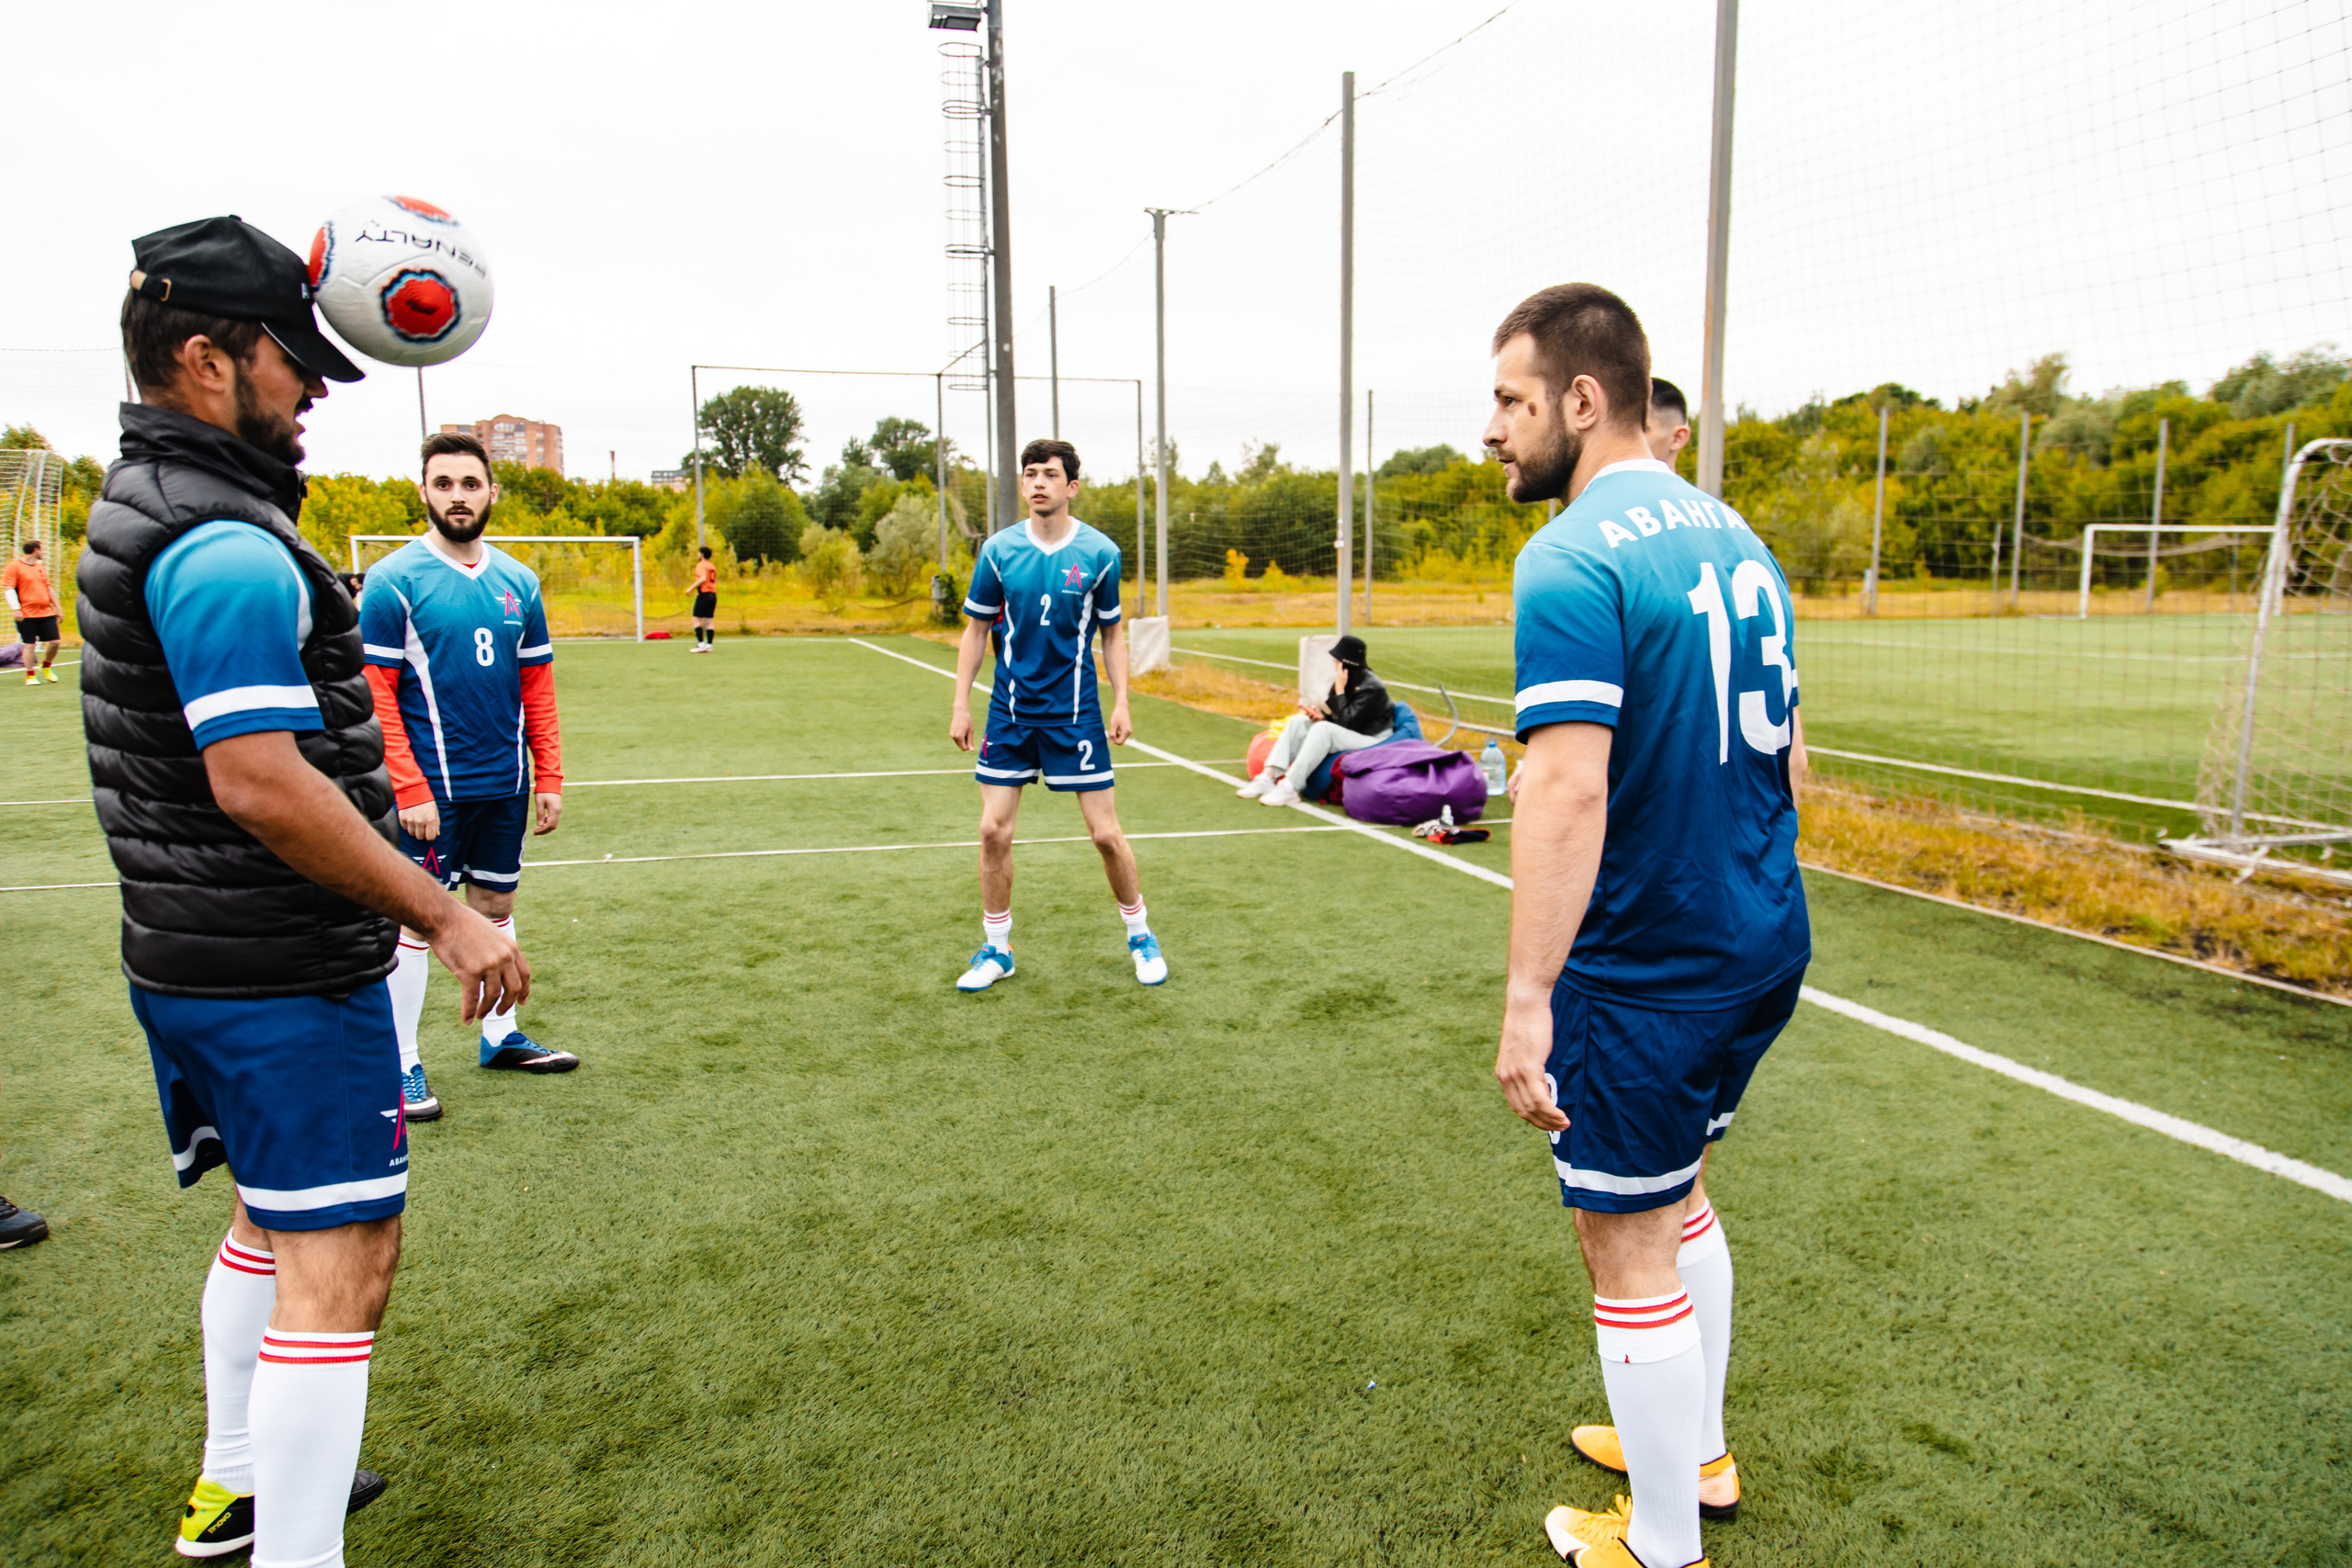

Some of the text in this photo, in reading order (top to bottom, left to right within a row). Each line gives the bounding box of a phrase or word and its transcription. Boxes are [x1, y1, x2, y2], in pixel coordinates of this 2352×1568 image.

[355, 229, 487, 278] PENALTY
[1598, 499, 1765, 548] АВАНГА
[1040, 593, 1051, 626] 2
[474, 627, 494, 667] 8
[1687, 559, 1792, 765] 13
[1078, 739, 1095, 771] 2
